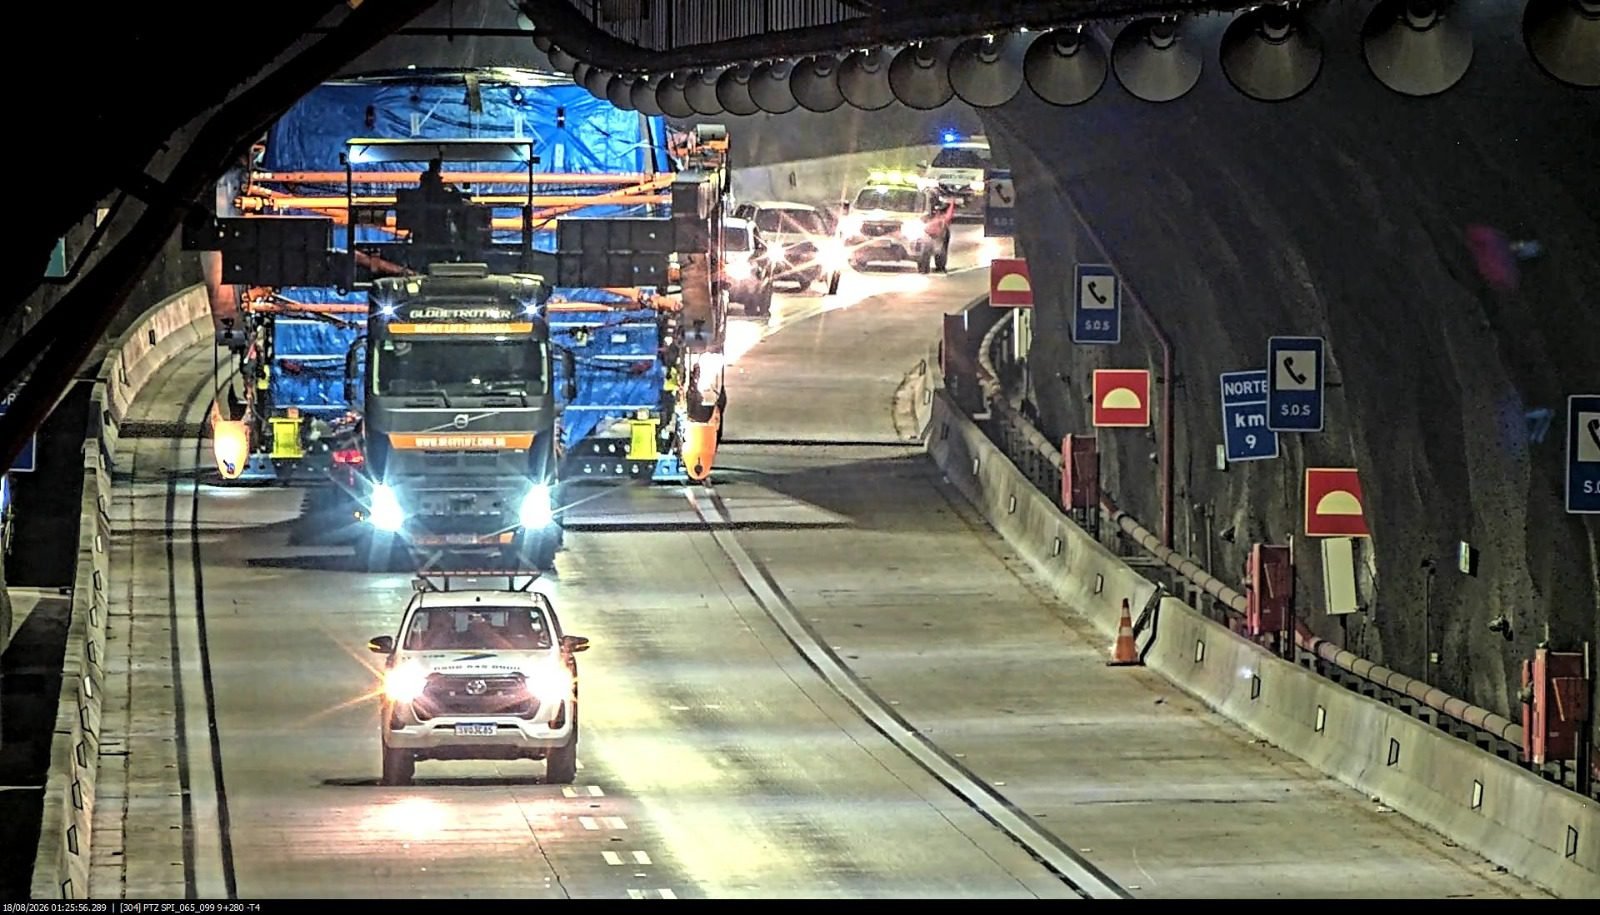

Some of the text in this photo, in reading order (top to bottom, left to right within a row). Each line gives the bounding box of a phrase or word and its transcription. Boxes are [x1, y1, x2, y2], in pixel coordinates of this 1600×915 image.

[1225, 381, 1267, 396] NORTE
[1235, 413, 1265, 428] km
[1245, 434, 1257, 449] 9
